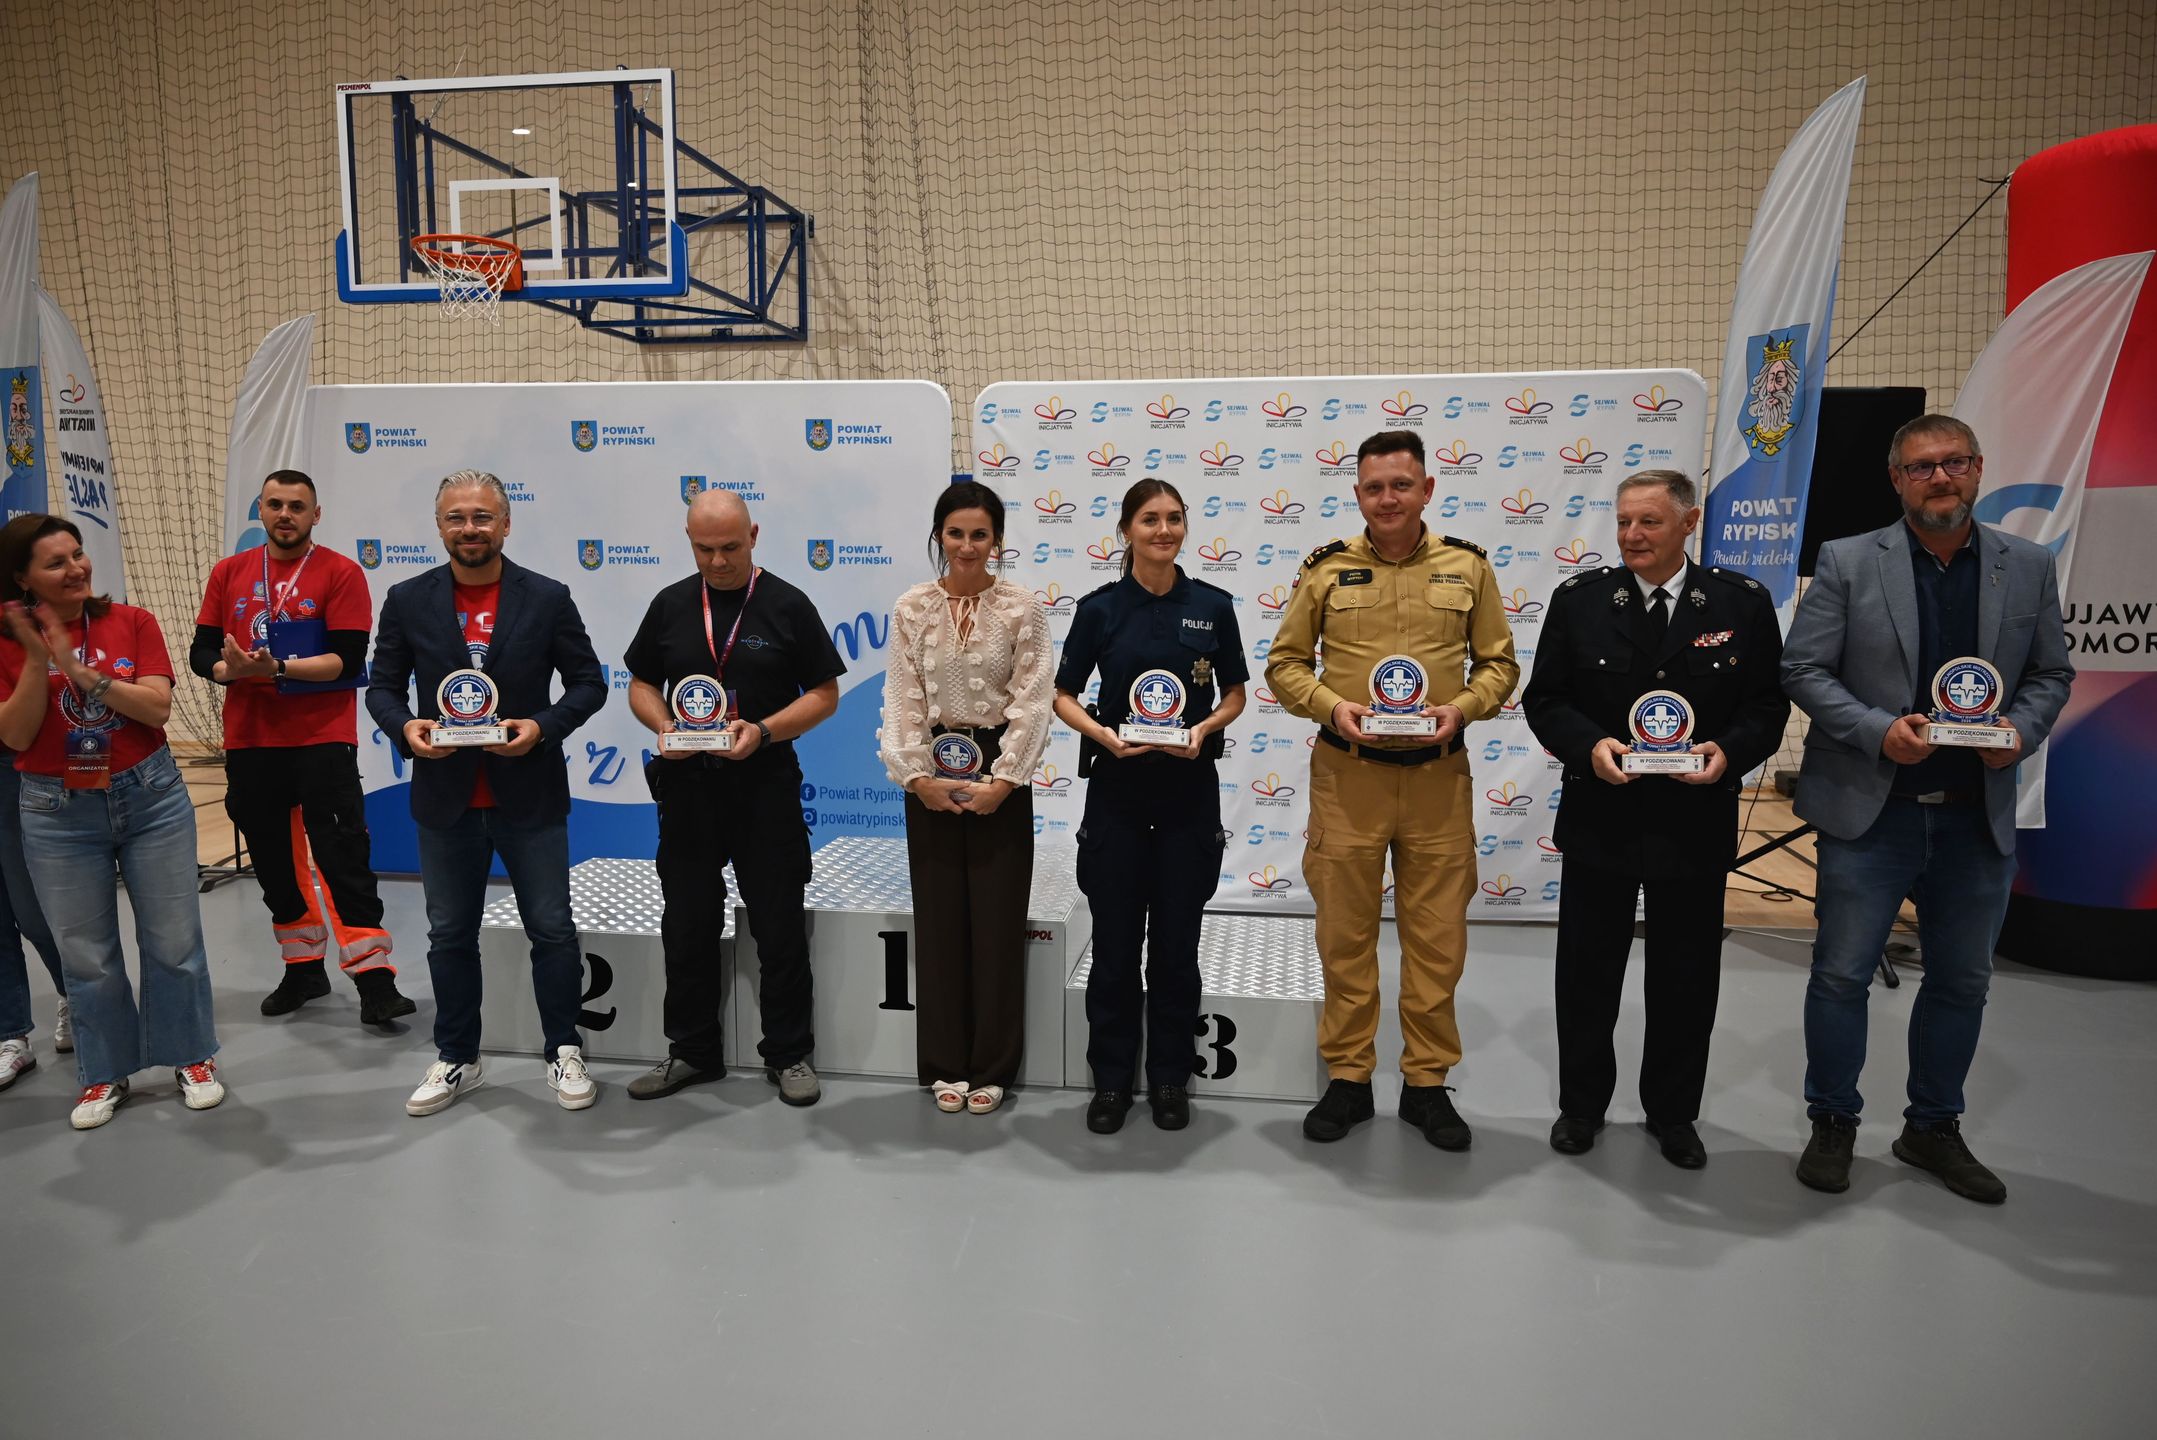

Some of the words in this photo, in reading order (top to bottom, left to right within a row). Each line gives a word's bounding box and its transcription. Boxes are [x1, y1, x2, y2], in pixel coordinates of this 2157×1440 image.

[838, 425, 882, 433] POWIAT
[377, 437, 426, 447] RYPIŃSKI
[603, 435, 655, 445] RYPIŃSKI
[838, 434, 892, 444] RYPIŃSKI
[712, 482, 754, 490] POWIAT
[509, 492, 534, 501] ŃSKI
[738, 491, 764, 501] ŃSKI
[608, 546, 649, 554] POWIAT
[387, 554, 436, 564] RYPIŃSKI
[608, 554, 659, 564] RYPIŃSKI
[839, 554, 892, 564] RYPIŃSKI
[1713, 550, 1750, 565] Powiat
[2062, 603, 2157, 624] UJAW
[1182, 618, 1213, 630] POLICJA
[2064, 632, 2157, 654] OMOR
[1941, 664, 1972, 688] OGÓLNOPOLSKIE
[820, 787, 860, 800] Powiat
[864, 787, 904, 803] Rypińs
[821, 813, 905, 827] powiatrypinsk
[878, 931, 916, 1011] 1
[1191, 1013, 1238, 1080] 3
